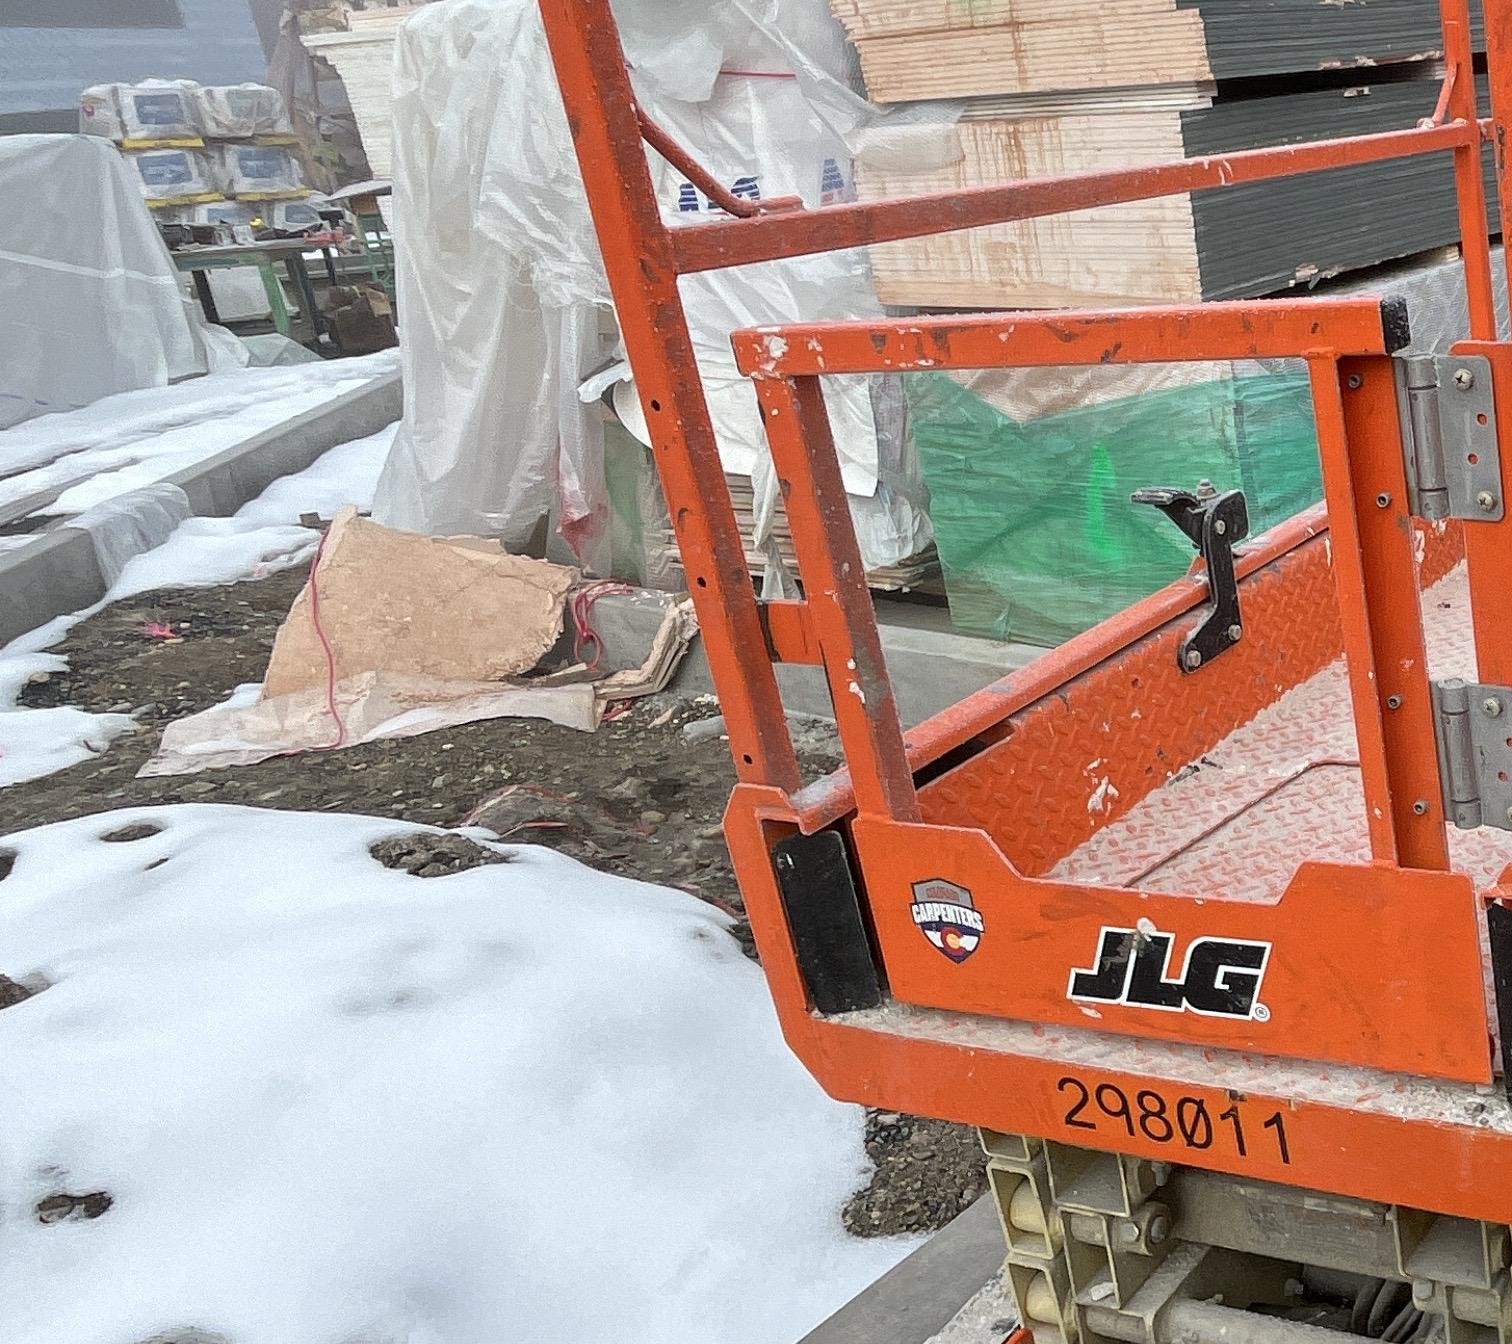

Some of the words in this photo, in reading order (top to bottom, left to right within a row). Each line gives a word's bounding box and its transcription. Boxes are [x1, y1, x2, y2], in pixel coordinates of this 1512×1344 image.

[911, 902, 985, 932] CARPENTERS
[1066, 925, 1273, 1021] JLG
[1057, 1076, 1291, 1164] 298011
